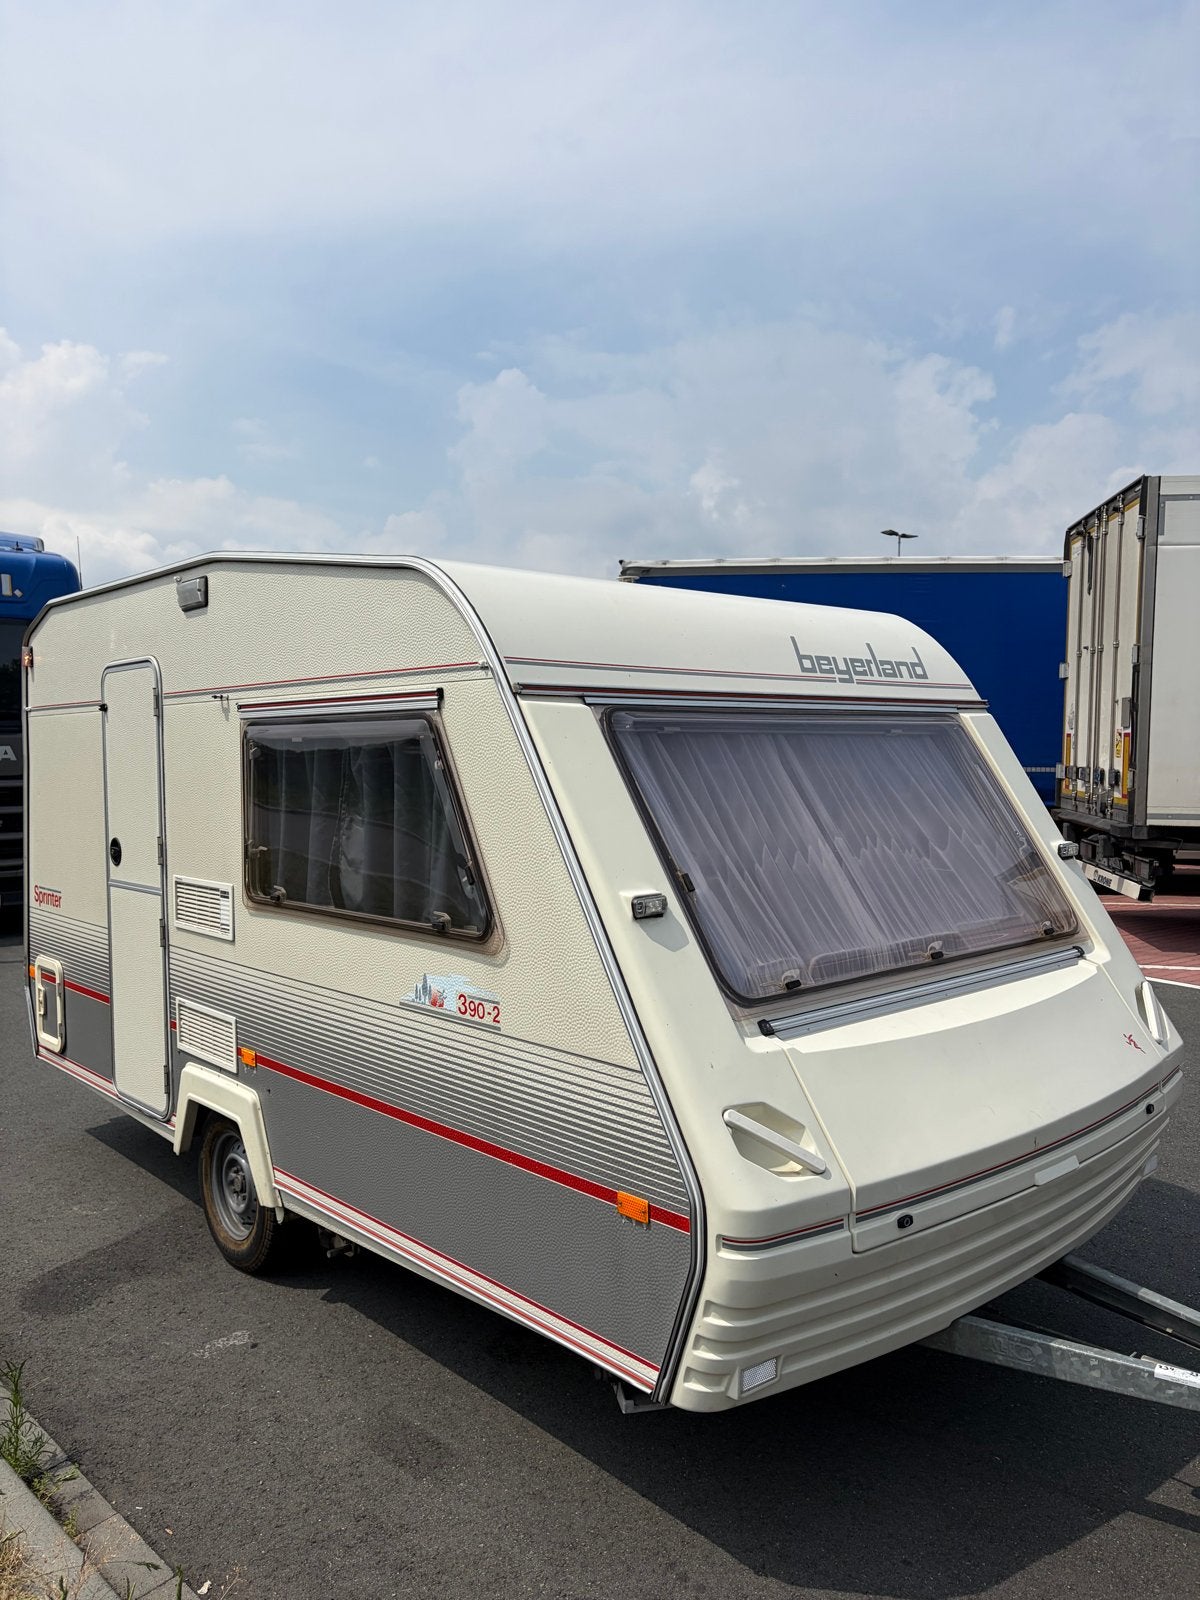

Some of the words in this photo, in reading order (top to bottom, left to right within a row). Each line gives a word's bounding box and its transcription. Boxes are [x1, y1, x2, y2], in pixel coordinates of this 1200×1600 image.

[789, 636, 929, 684] beyerland
[34, 884, 62, 908] Sprinter
[457, 993, 501, 1024] 390-2
